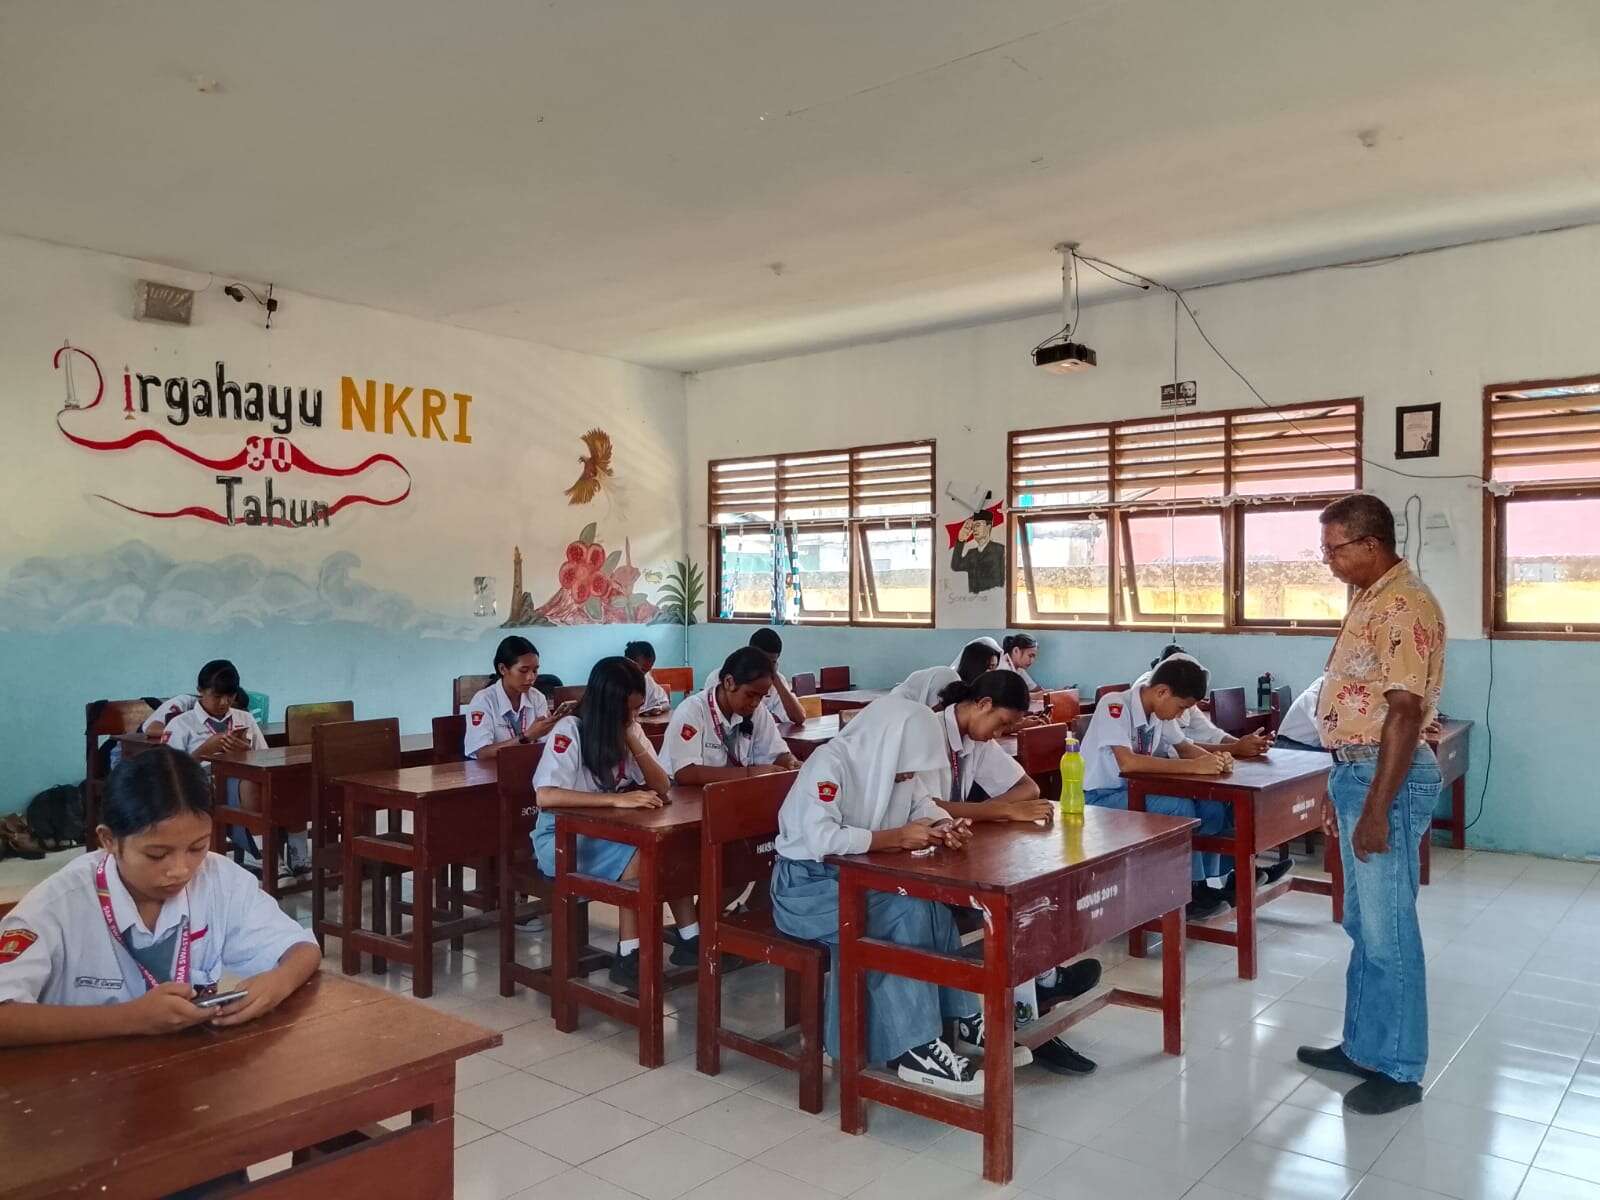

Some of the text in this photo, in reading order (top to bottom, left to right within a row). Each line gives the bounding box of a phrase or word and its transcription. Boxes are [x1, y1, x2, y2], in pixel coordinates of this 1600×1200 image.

[54, 341, 474, 444] Dirgahayu NKRI
[216, 475, 331, 529] Tahun
[1101, 885, 1118, 901] 2019
[176, 929, 190, 985] SMA SWASTA
